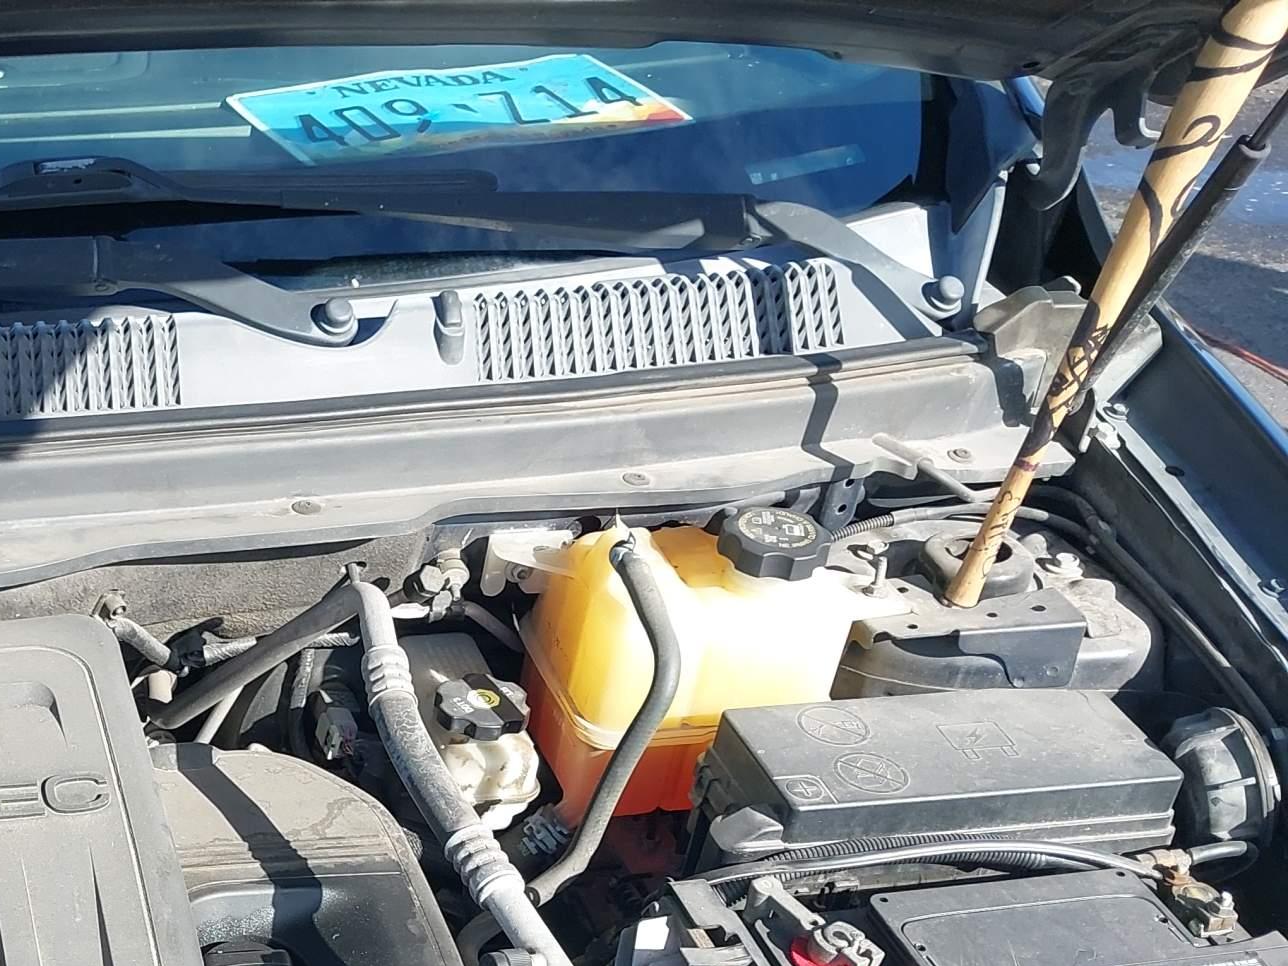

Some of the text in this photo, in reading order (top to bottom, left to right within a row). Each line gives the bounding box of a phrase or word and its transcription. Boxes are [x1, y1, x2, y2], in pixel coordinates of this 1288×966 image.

[331, 70, 515, 98] NEVADA
[297, 76, 644, 146] 409 Z14
